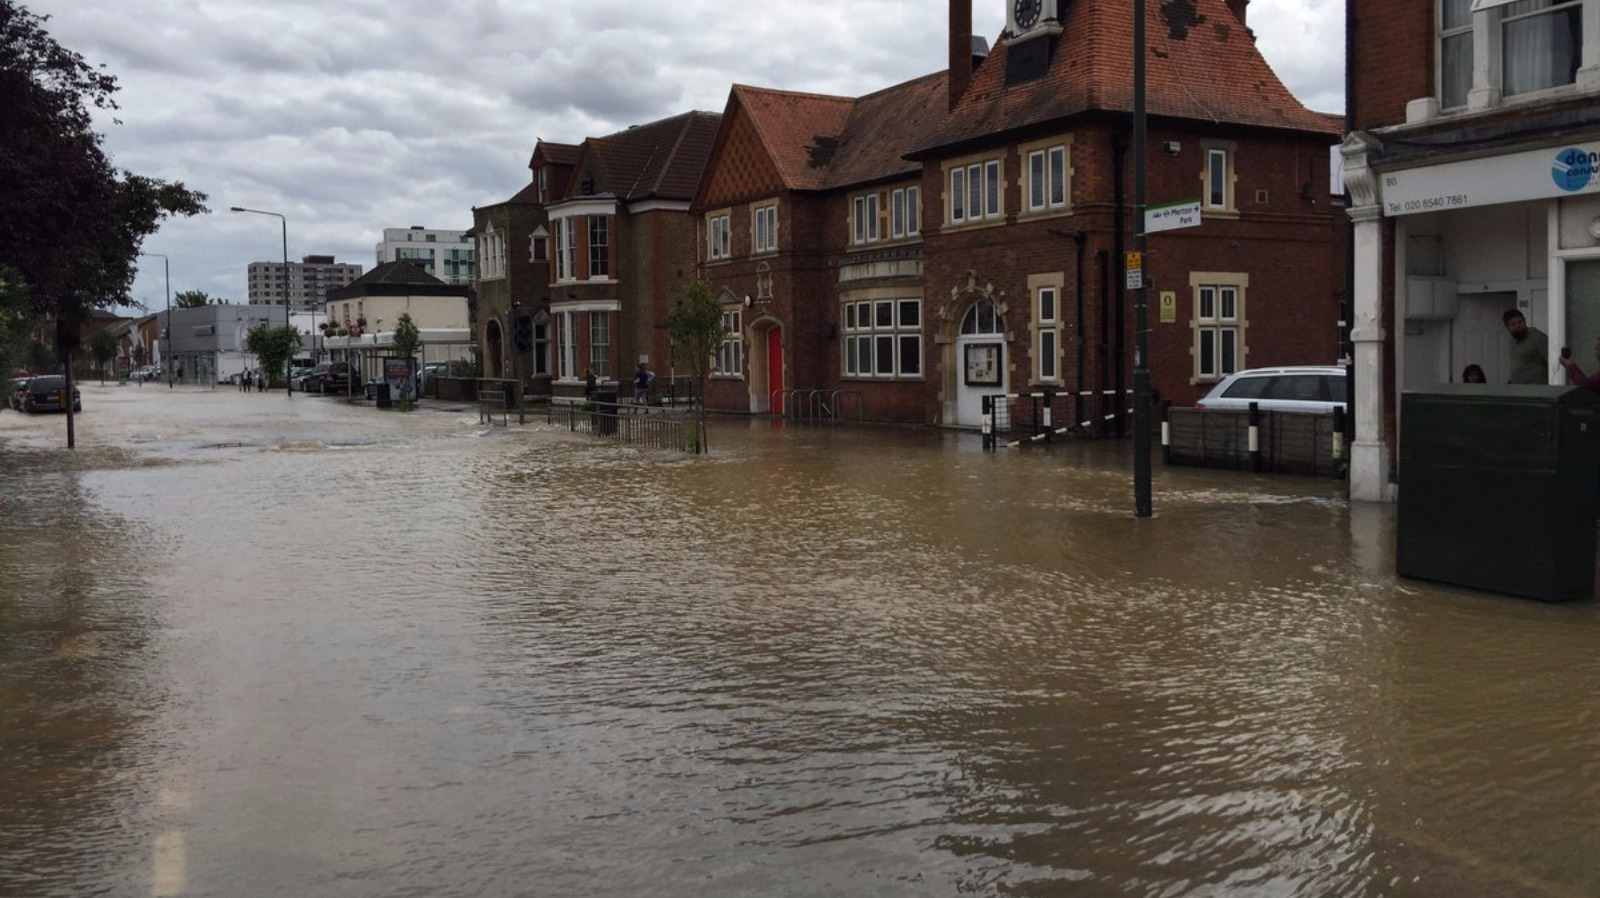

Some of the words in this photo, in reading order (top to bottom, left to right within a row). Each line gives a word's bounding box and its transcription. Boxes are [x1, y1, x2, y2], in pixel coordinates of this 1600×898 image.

[1566, 151, 1600, 165] dan
[1386, 177, 1396, 186] 80
[1404, 200, 1420, 210] 020
[1171, 208, 1192, 216] Merton
